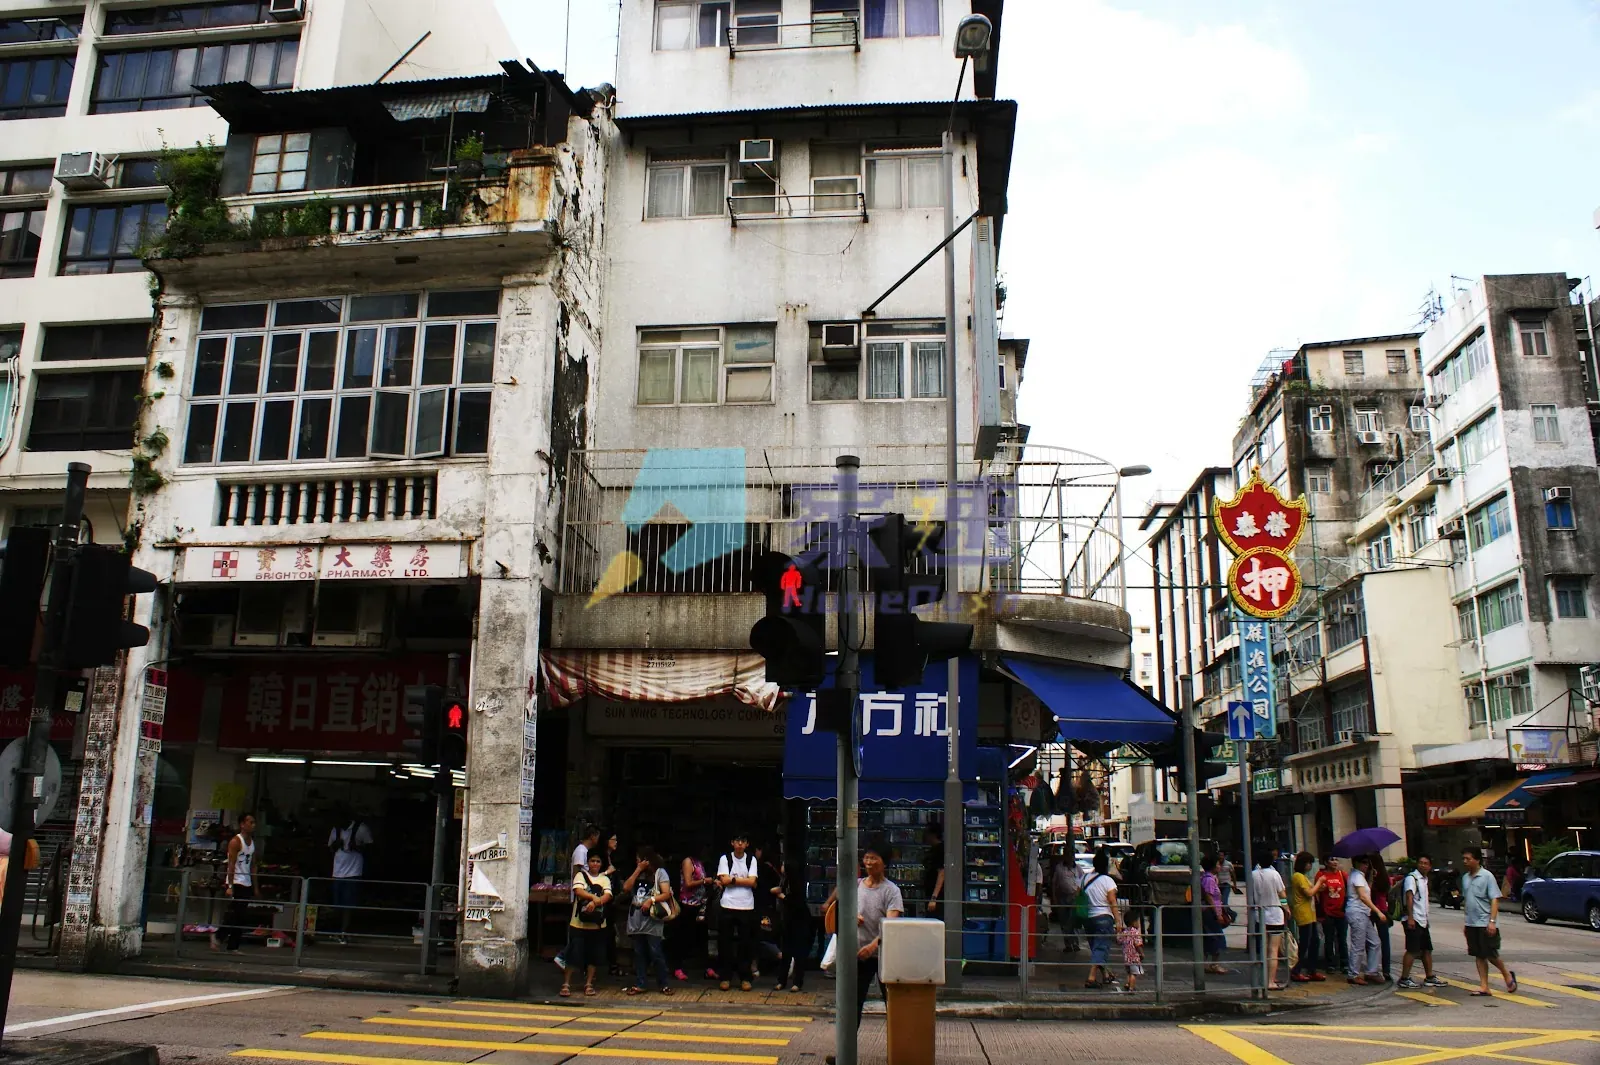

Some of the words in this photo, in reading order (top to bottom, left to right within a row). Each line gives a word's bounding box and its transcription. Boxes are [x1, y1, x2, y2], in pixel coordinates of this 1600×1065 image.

[256, 571, 315, 580] BRIGHTON
[327, 569, 395, 578] PHARMACY
[405, 568, 429, 577] LTD.
[1241, 557, 1291, 608] 押
[605, 707, 626, 718] SUN
[661, 707, 732, 720] TECHNOLOGY
